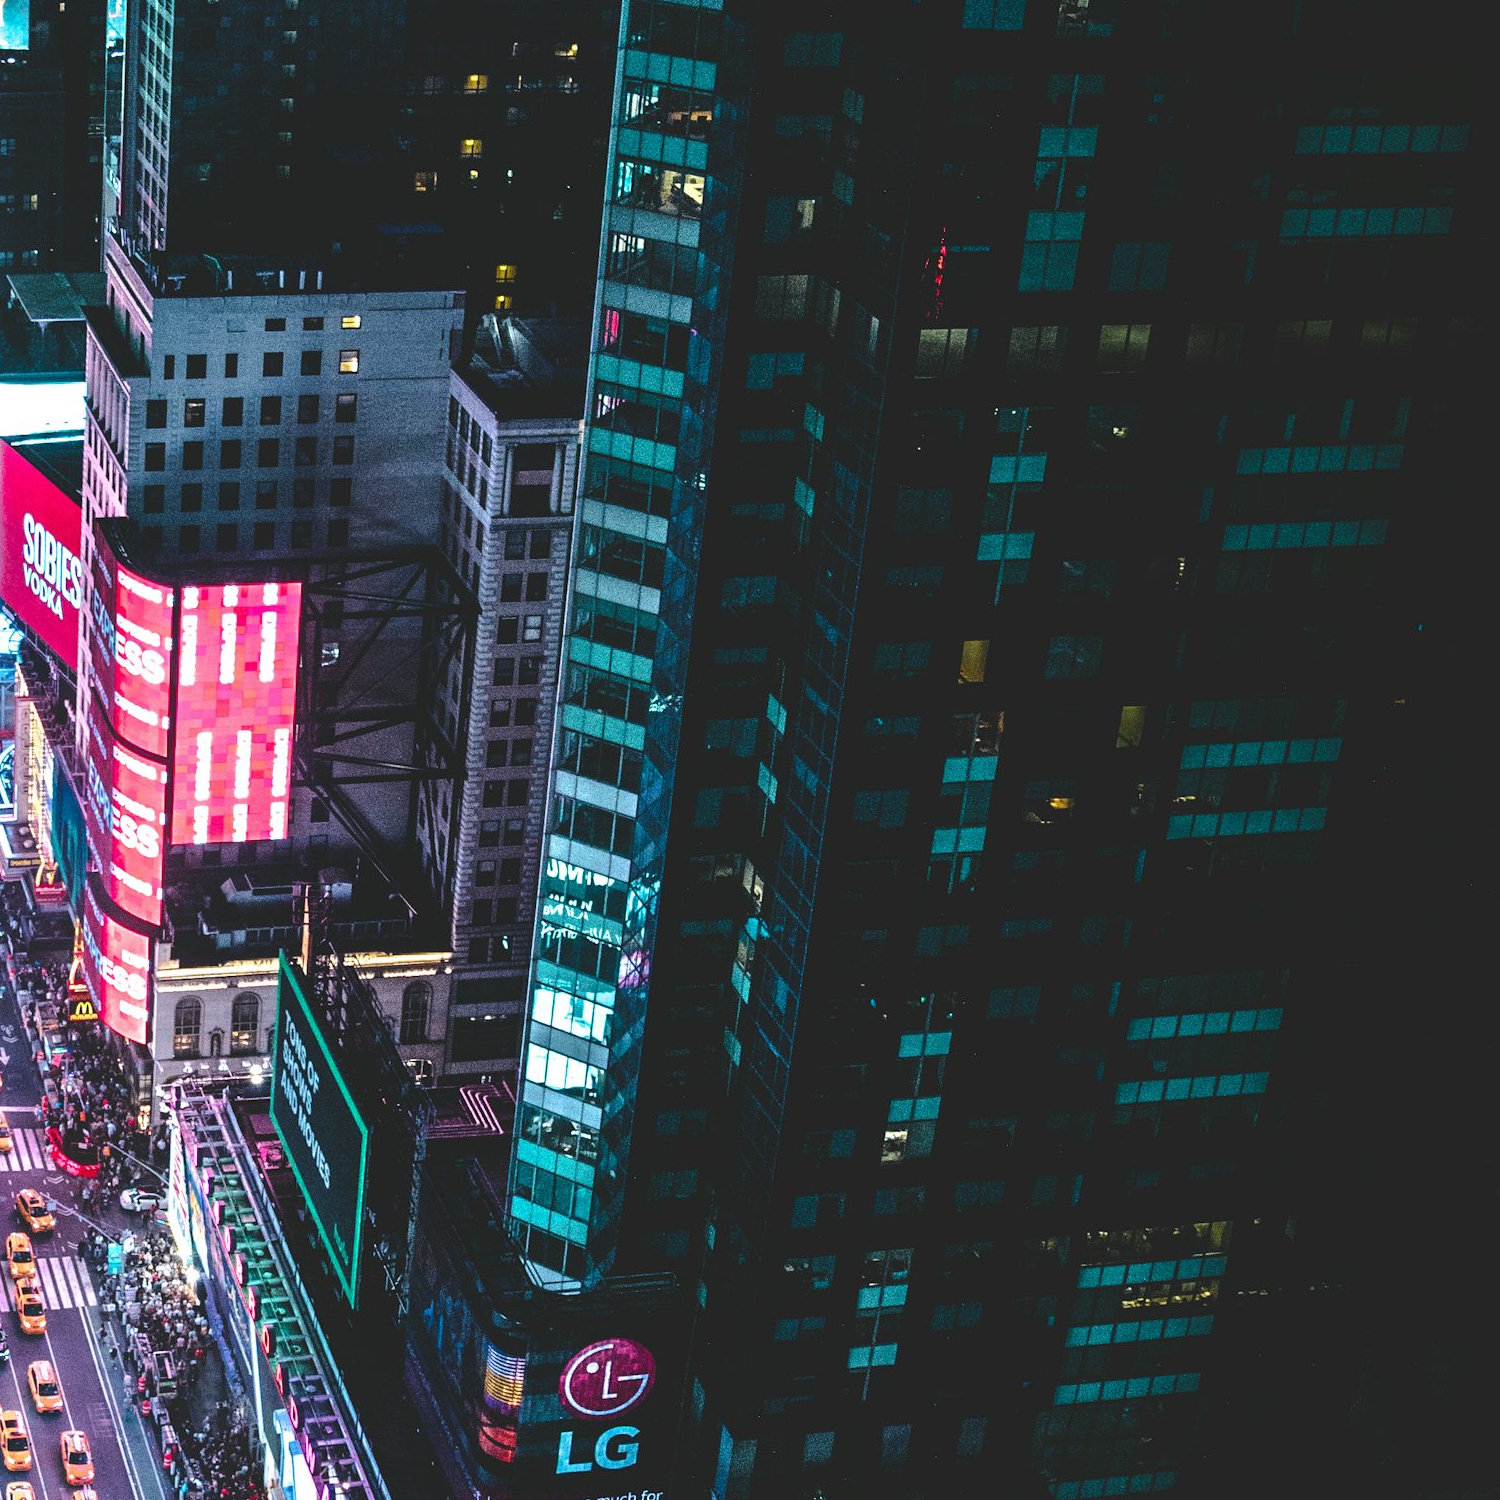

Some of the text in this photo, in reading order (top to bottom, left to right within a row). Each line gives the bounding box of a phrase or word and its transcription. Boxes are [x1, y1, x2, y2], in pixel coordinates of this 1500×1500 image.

[23, 513, 83, 610] SOBIES
[23, 563, 64, 620] VODKA
[282, 1039, 312, 1116] SHOWS
[284, 1009, 320, 1094] TONS OF
[281, 1068, 331, 1189] AND MOVIES
[556, 1425, 641, 1475] LG
